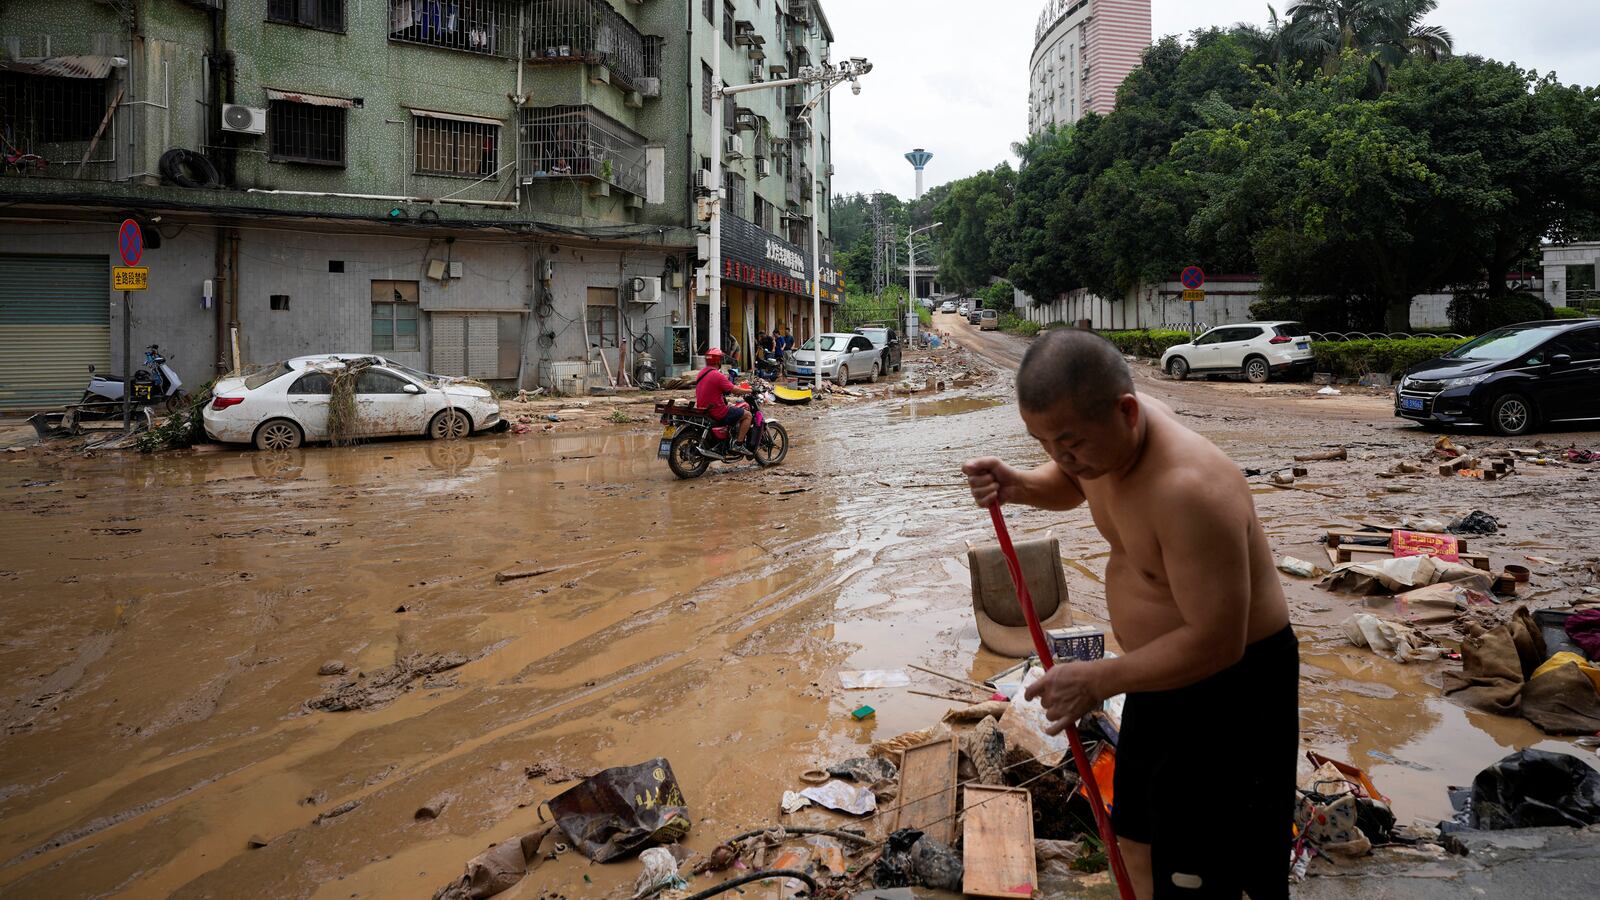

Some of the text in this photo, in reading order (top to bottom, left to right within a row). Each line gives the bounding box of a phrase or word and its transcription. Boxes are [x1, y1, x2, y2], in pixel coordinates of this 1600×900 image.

[115, 271, 147, 285] 全路段禁停
